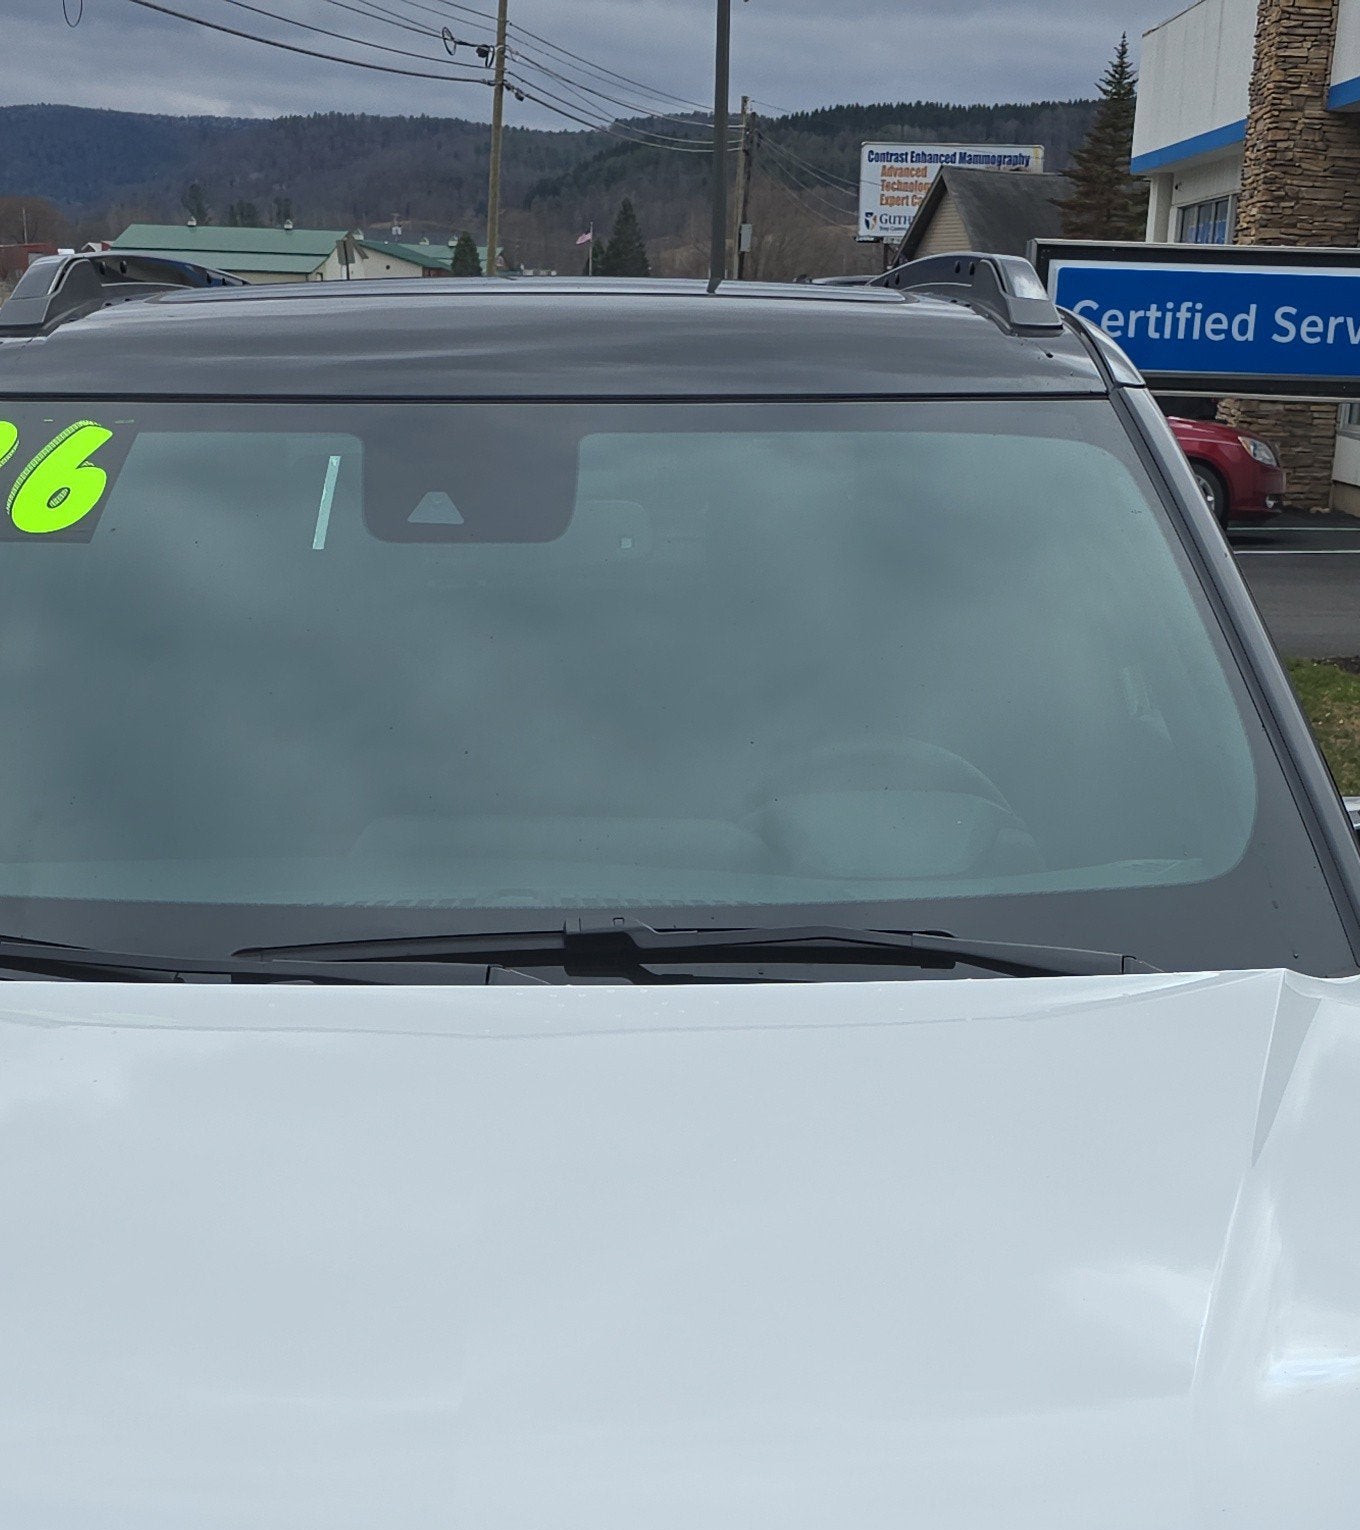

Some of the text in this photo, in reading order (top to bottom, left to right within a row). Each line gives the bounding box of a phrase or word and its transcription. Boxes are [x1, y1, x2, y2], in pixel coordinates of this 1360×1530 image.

[868, 150, 1030, 167] Contrast Enhanced Mammography
[881, 165, 928, 178] Advanced
[881, 179, 932, 193] Technolog
[880, 194, 909, 207] Expert
